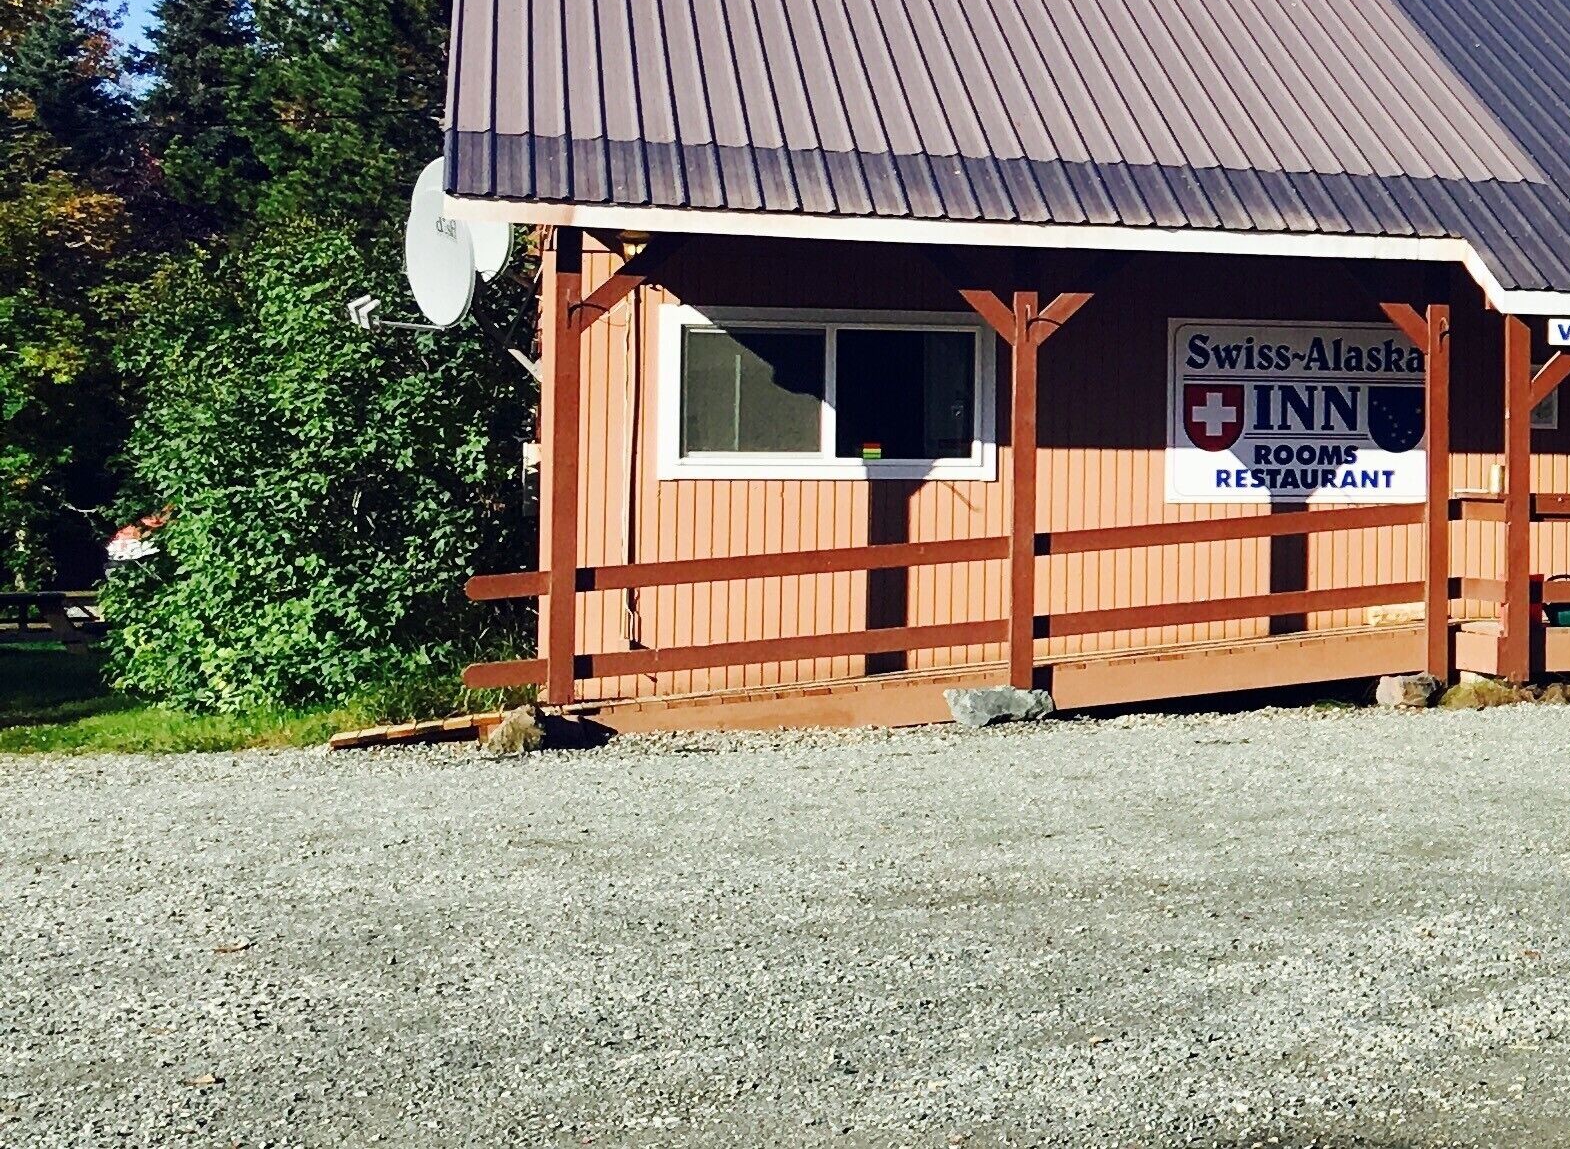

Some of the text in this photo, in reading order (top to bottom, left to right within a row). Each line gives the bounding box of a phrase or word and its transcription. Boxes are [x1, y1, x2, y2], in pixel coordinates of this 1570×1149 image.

[1253, 384, 1361, 431] INN
[1254, 444, 1359, 465] ROOMS
[1215, 468, 1396, 489] RESTAURANT
